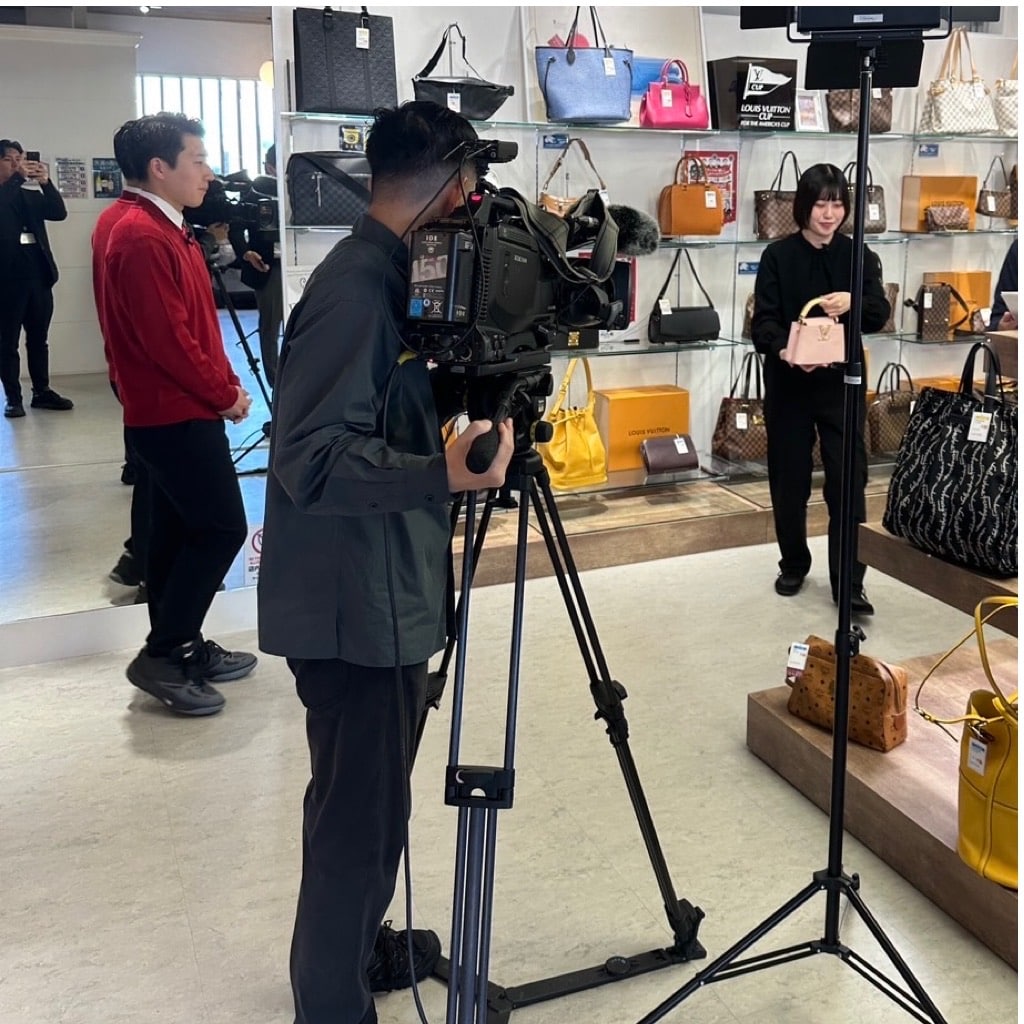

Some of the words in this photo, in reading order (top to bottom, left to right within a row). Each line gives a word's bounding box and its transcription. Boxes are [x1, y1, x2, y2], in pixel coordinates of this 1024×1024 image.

[741, 104, 761, 113] LOUIS
[762, 105, 791, 114] VUITTON
[759, 112, 773, 120] CUP
